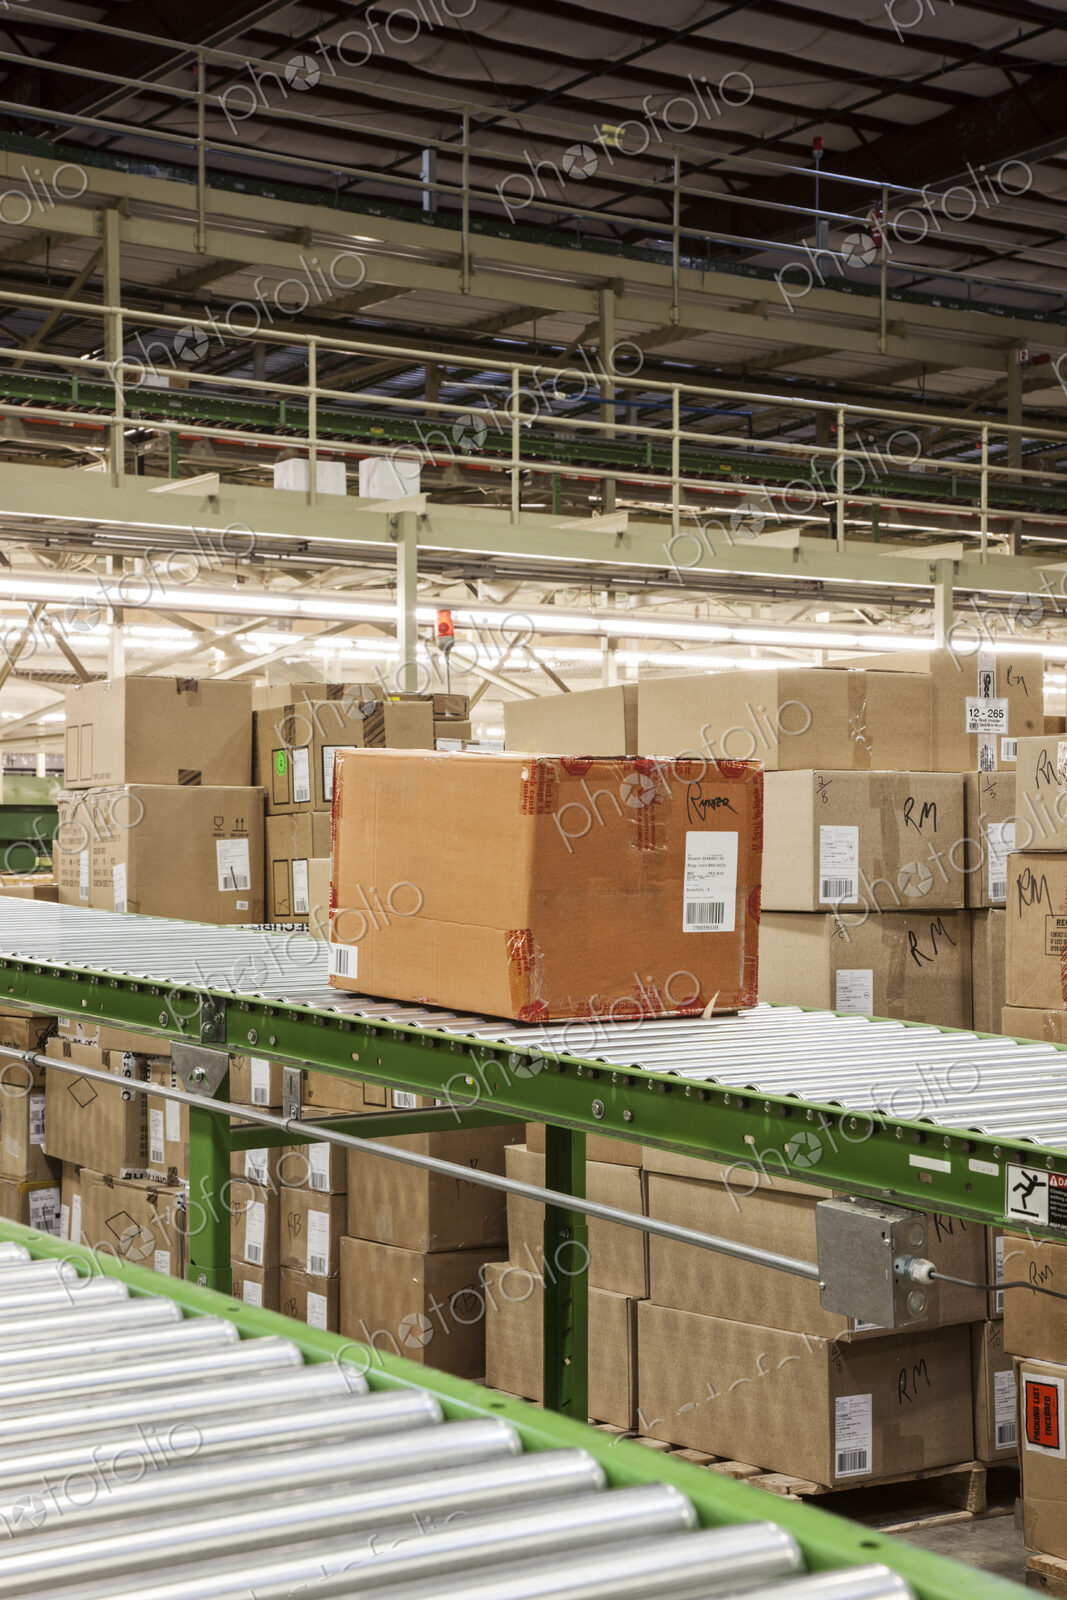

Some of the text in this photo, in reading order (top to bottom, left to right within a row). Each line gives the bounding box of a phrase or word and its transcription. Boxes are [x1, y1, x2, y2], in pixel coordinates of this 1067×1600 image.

[969, 708, 980, 718] 12
[987, 709, 1004, 718] 265
[903, 797, 938, 835] RM
[1032, 1386, 1041, 1441] PACKING LIST
[1043, 1395, 1052, 1436] ENCLOSED
